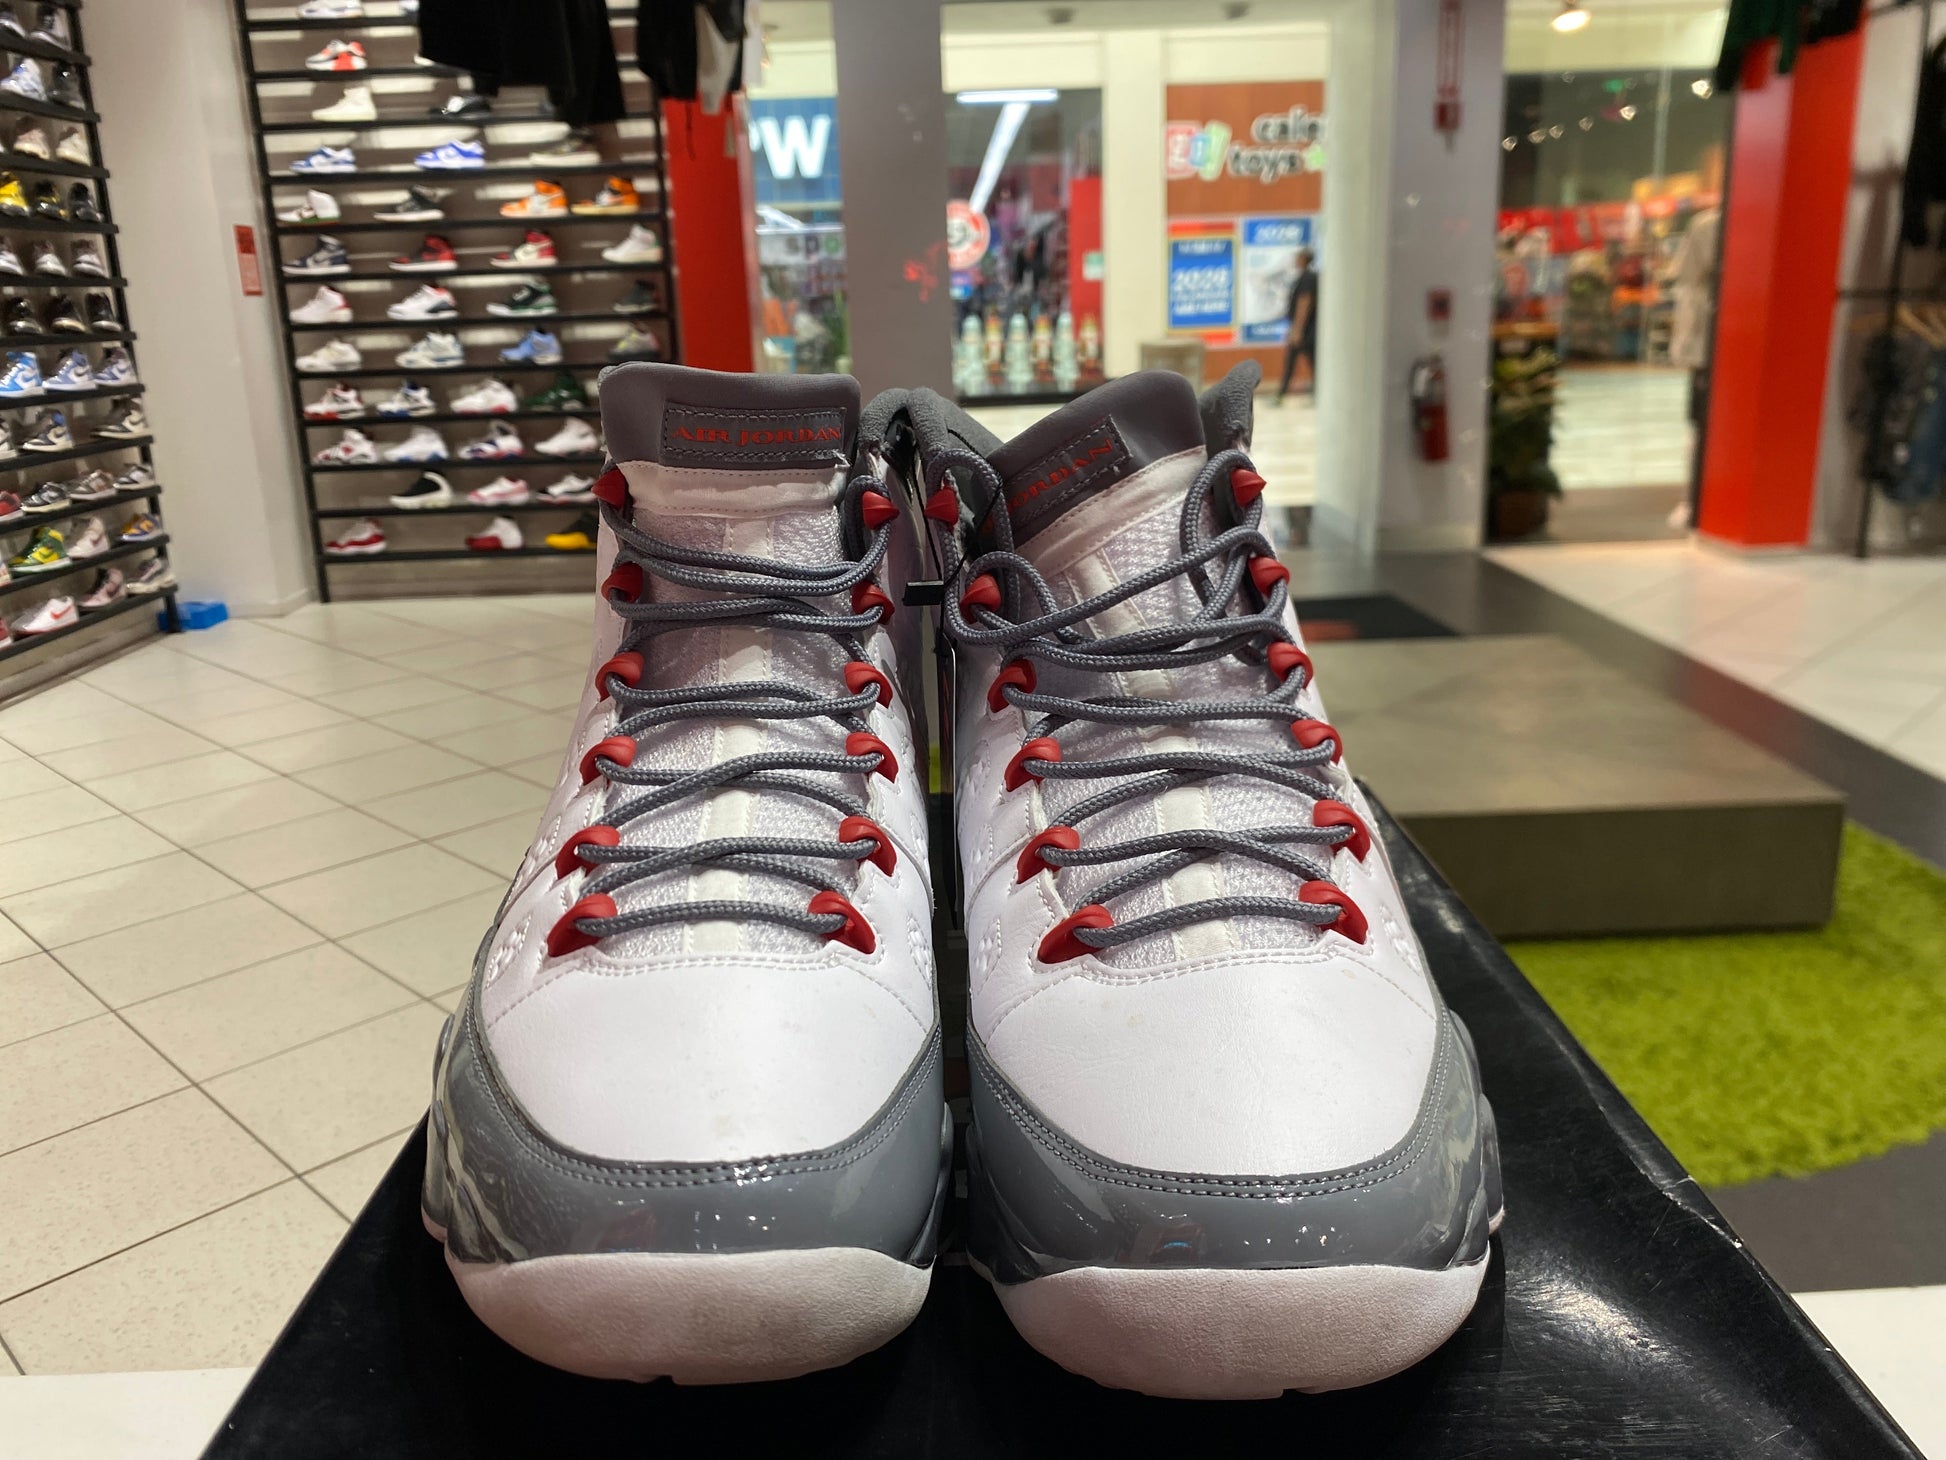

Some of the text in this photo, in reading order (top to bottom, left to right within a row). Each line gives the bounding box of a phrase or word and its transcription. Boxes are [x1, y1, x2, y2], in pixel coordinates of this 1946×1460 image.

[1228, 144, 1303, 183] toys
[672, 424, 842, 447] AIR JORDAN
[1006, 438, 1113, 515] ORDAN
